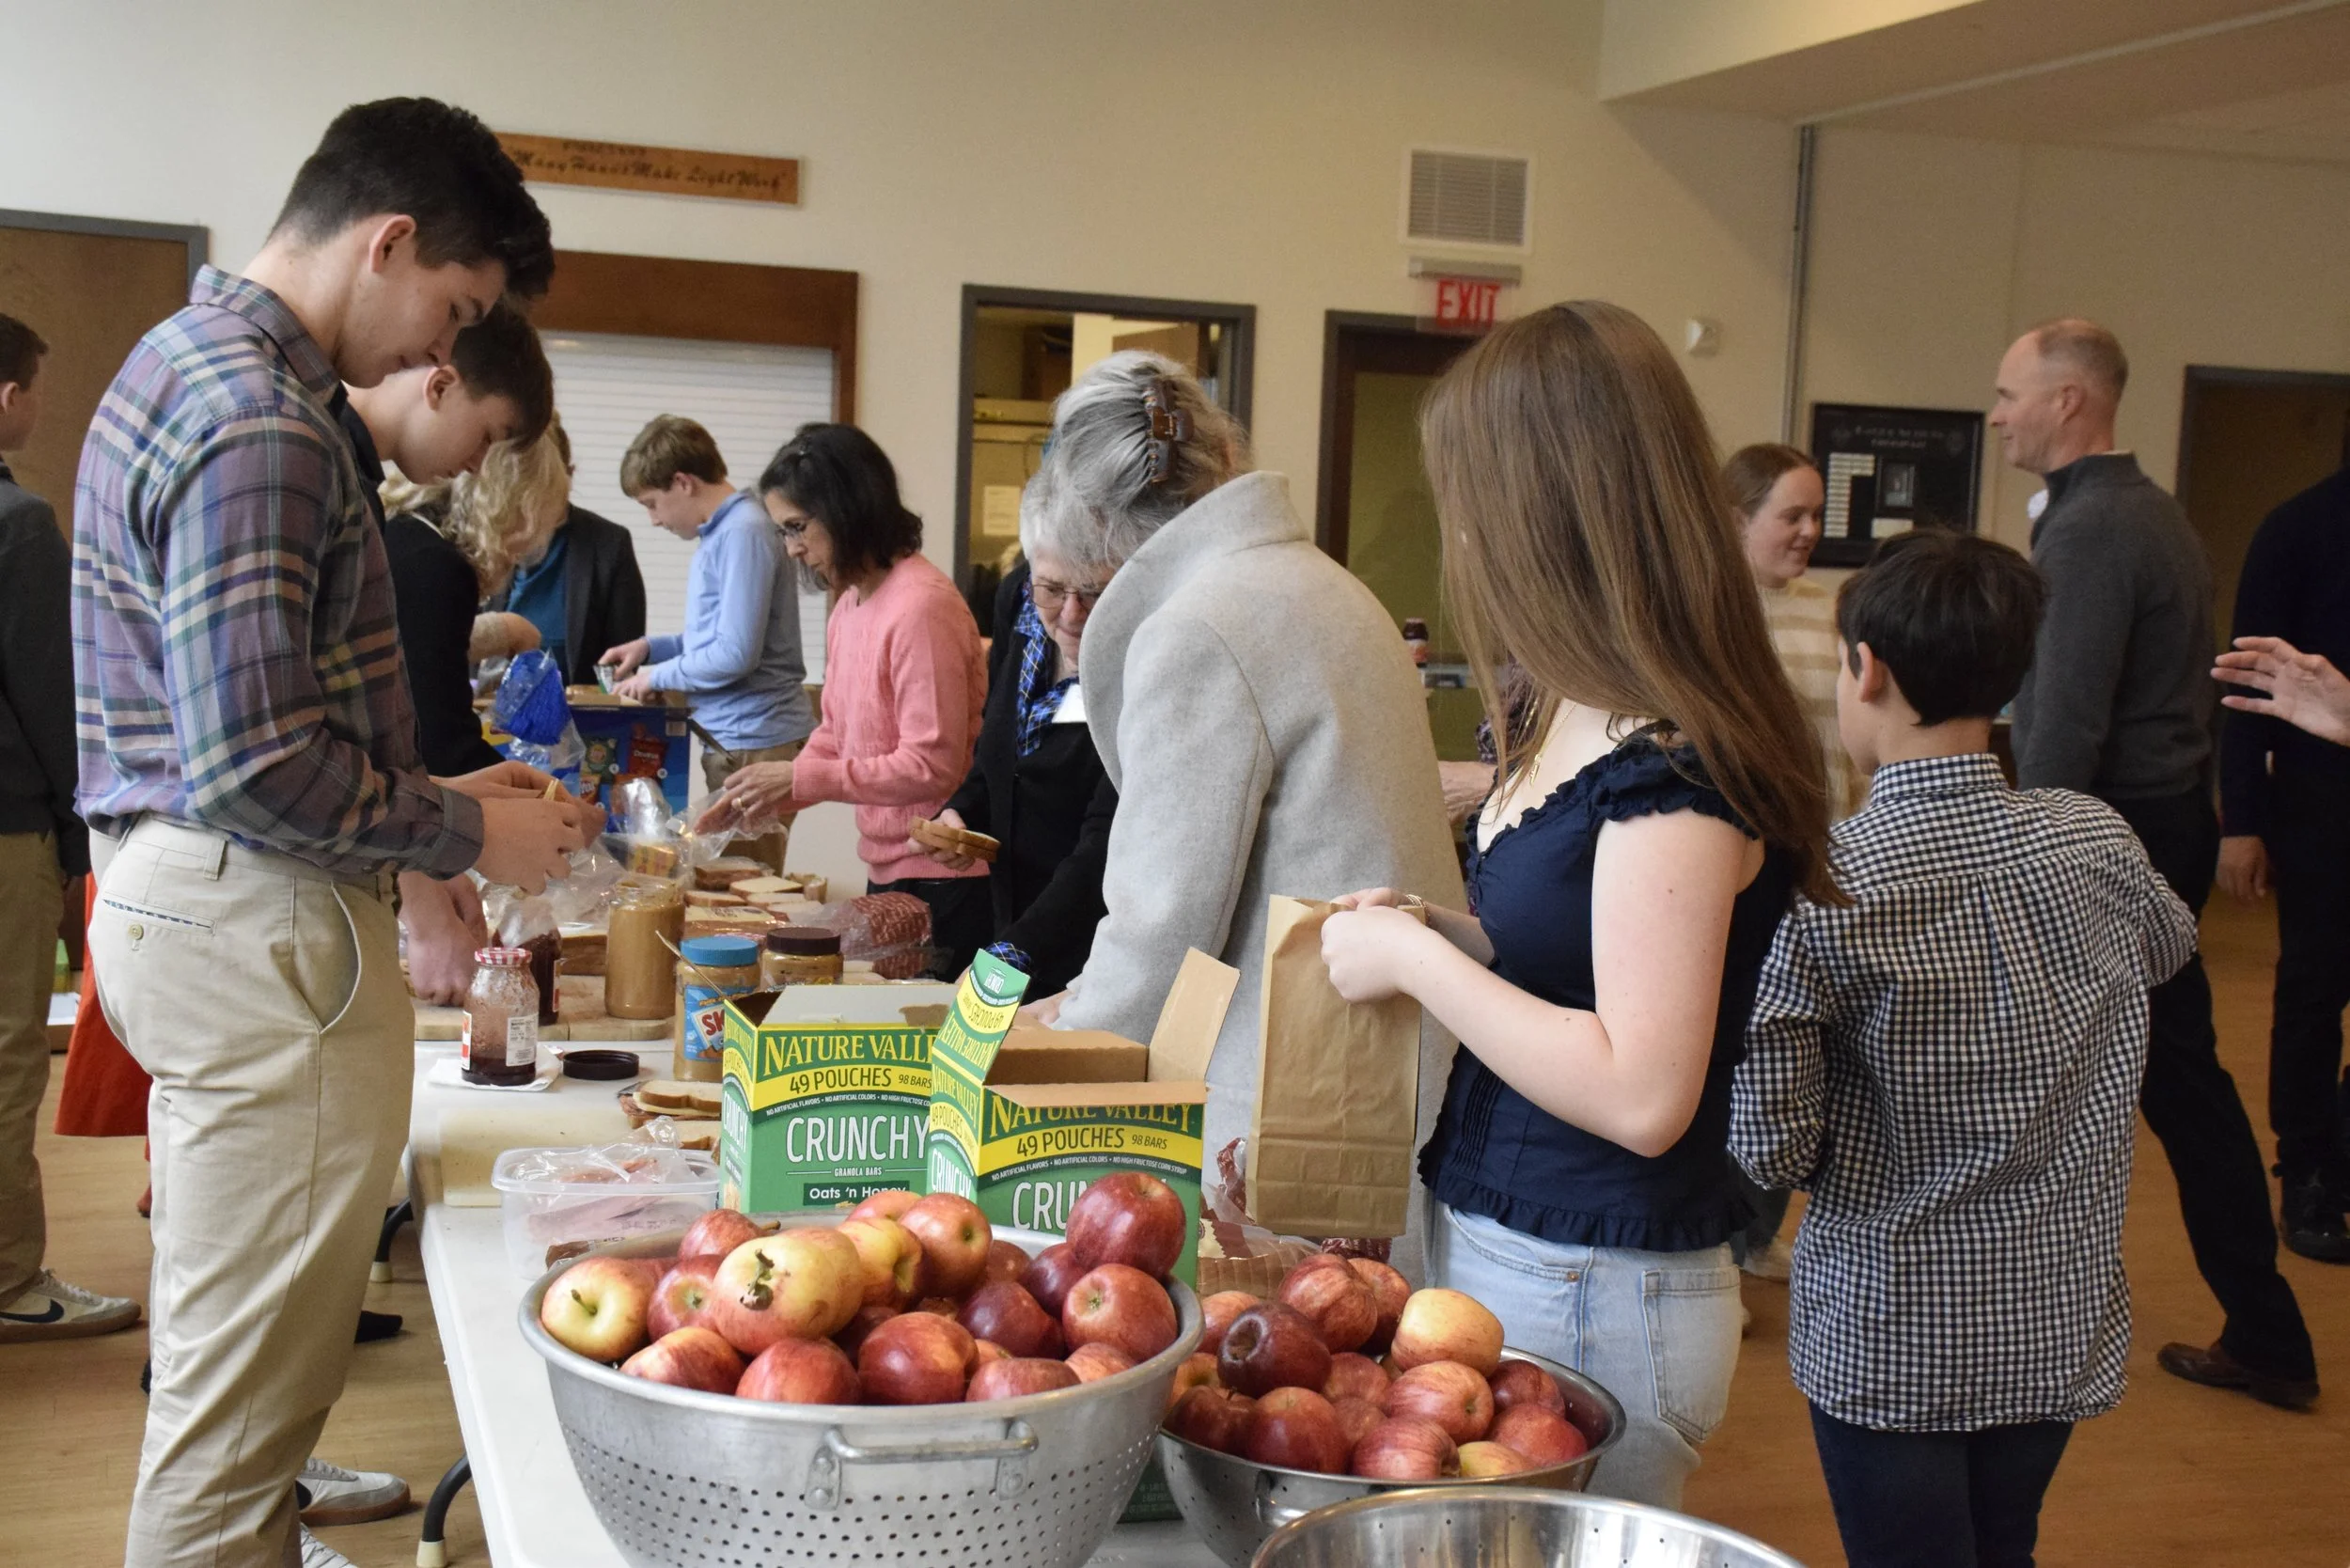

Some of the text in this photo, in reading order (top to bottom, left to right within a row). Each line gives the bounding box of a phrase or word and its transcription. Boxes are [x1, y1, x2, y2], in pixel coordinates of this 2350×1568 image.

[1437, 279, 1500, 328] EXIT
[763, 1035, 865, 1076] NATURE
[790, 1067, 932, 1094] 49 POUCHES 98 BARS
[766, 1108, 775, 1117] NO
[774, 1102, 799, 1114] ARTIFICIAL
[800, 1097, 821, 1107] FLAVORS
[900, 1096, 923, 1105] FRUCTOSE
[787, 1115, 930, 1163] CRUNCHY
[1017, 1128, 1167, 1157] 49 POUCHES 98 BARS
[834, 1167, 882, 1177] GRANOLA BARS
[992, 1172, 1000, 1181] NO
[1000, 1166, 1026, 1179] ARTIFICIAL
[1026, 1161, 1049, 1172] FLAVORS
[1061, 1156, 1088, 1165] ARTIFICIAL
[1133, 1157, 1157, 1168] FRUCTOSE
[1158, 1162, 1171, 1171] CORN
[1171, 1164, 1187, 1174] SYRUP
[809, 1187, 840, 1200] Oats
